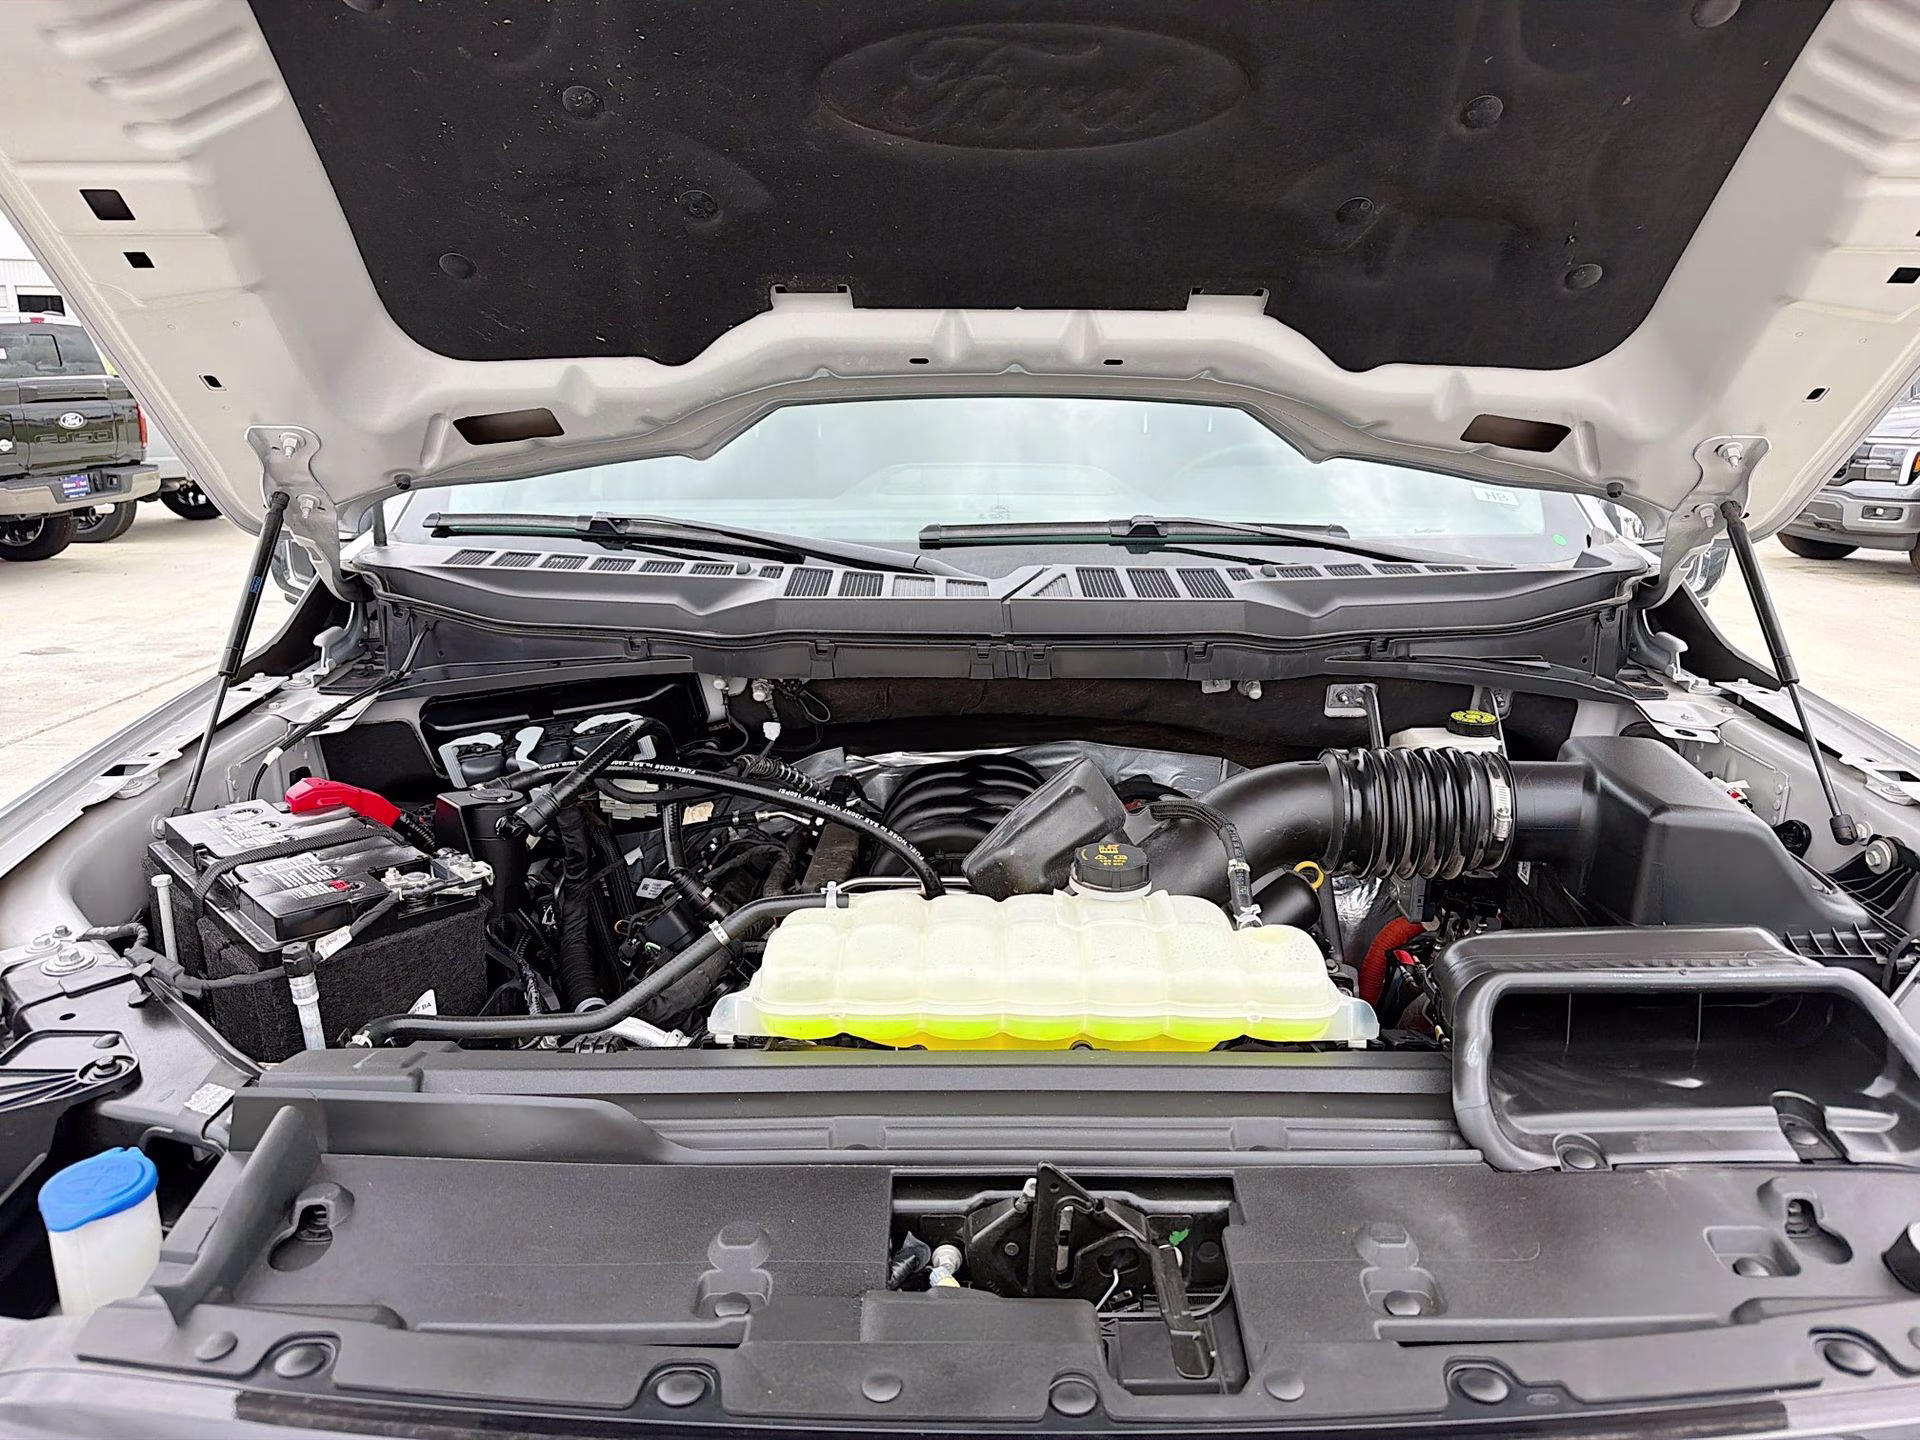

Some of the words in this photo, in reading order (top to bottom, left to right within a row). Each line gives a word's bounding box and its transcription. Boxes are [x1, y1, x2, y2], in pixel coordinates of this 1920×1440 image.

[654, 763, 675, 772] HOSE
[802, 794, 818, 804] W/P
[864, 816, 880, 828] SAE
[888, 828, 907, 846] HOSE
[908, 843, 926, 861] FUEL
